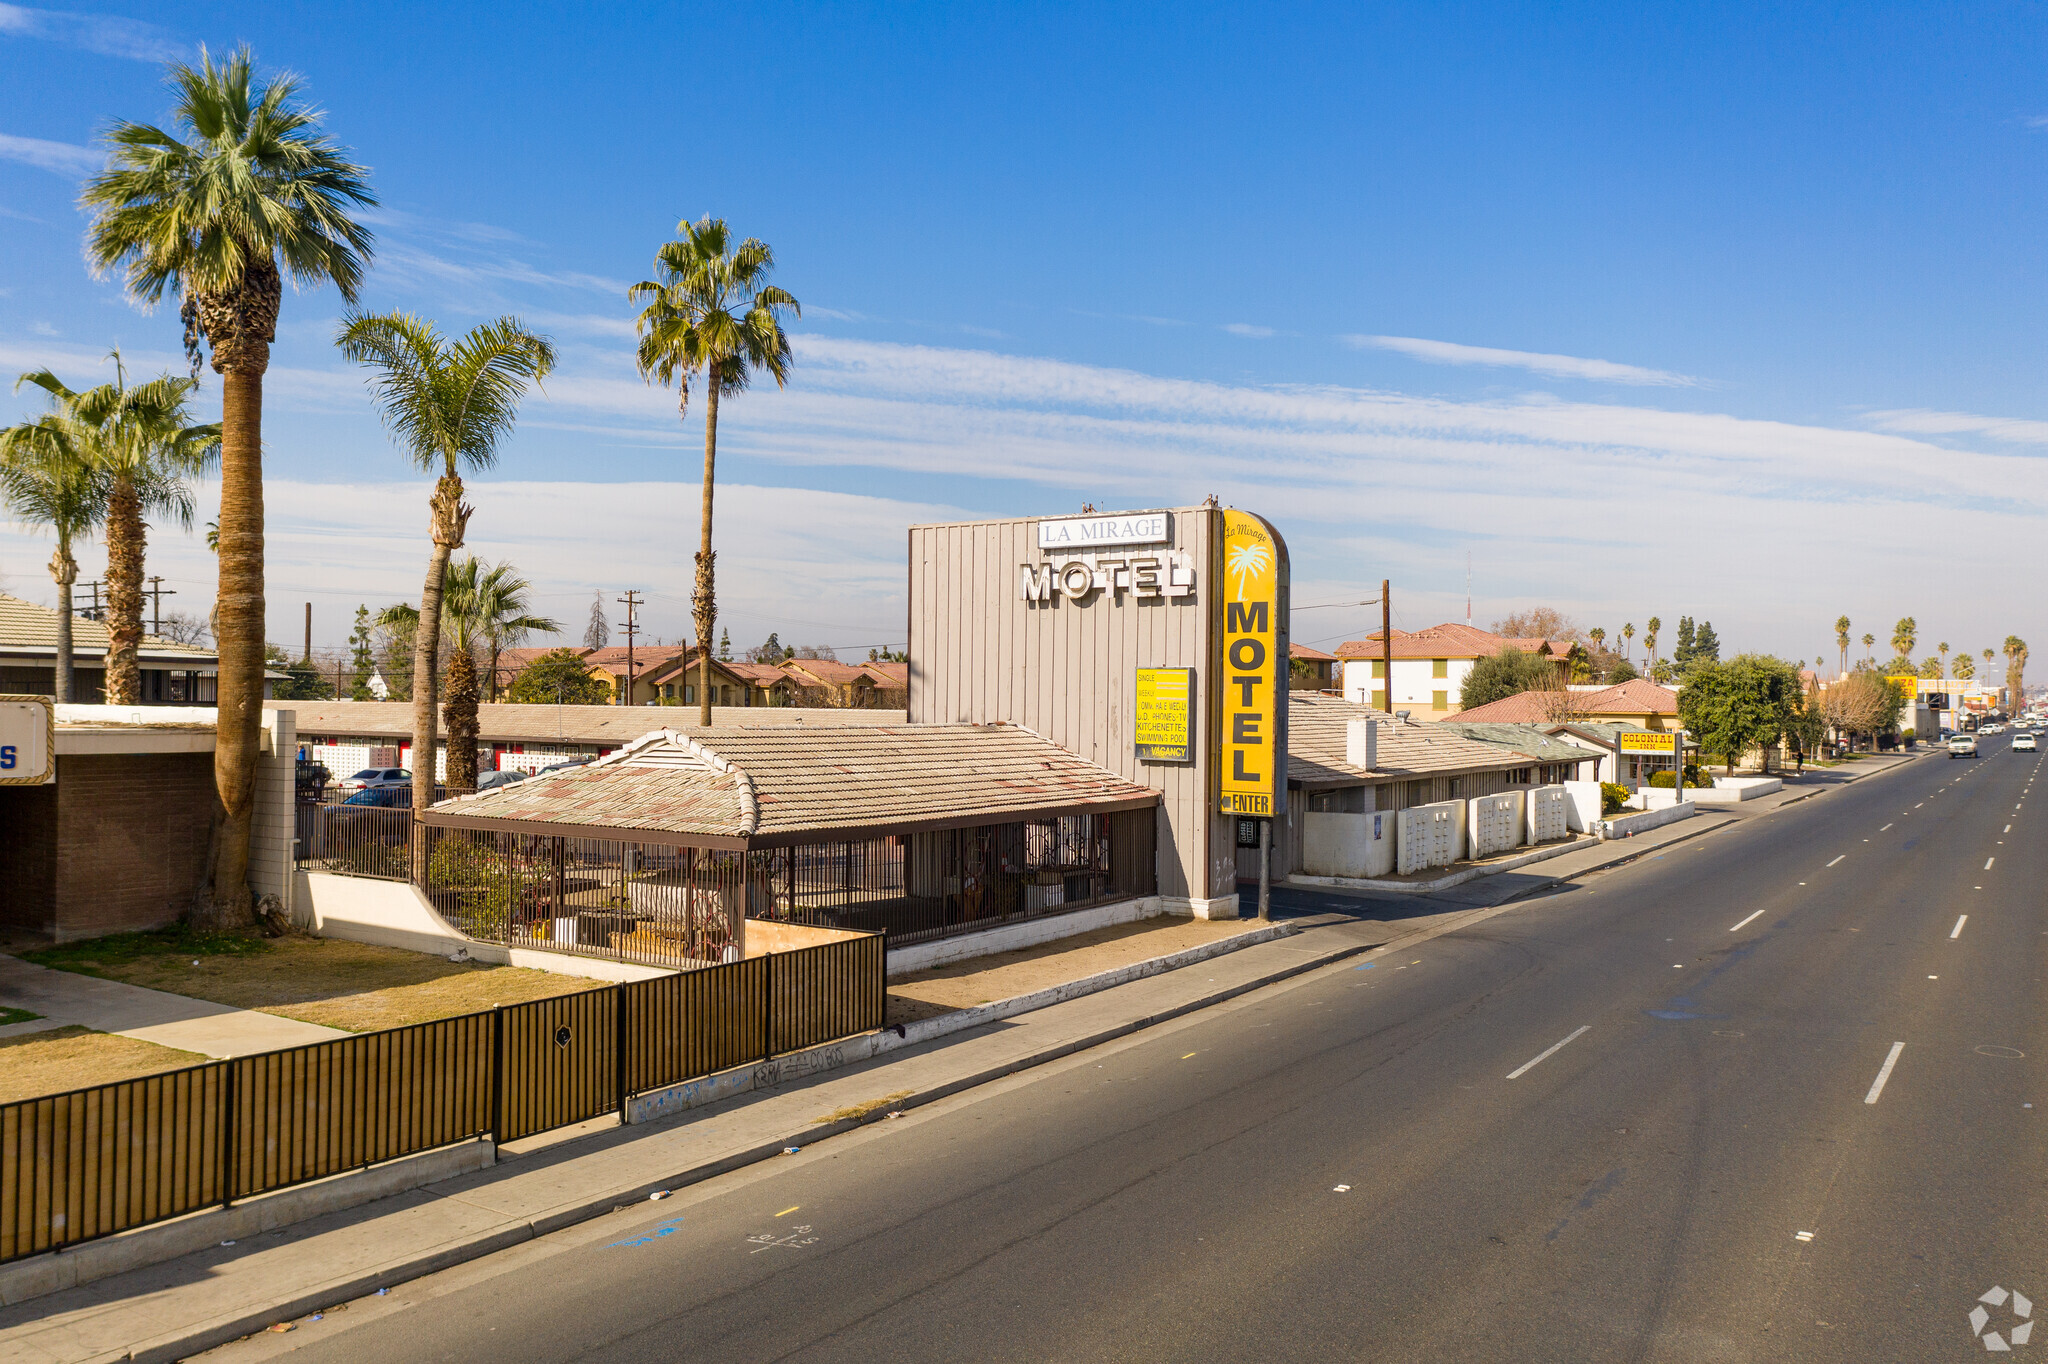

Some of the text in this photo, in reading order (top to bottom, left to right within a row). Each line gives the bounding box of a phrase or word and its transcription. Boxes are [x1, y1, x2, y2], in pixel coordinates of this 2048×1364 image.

[1045, 518, 1163, 542] LA MIRAGE
[1226, 523, 1267, 543] La Mirage
[1019, 557, 1189, 601] MOTEL
[1138, 674, 1155, 682] SINGLE
[1928, 680, 1974, 688] BEAUTY
[1227, 601, 1269, 782] MOTEL
[1136, 722, 1187, 732] KITCHENETTES
[1136, 733, 1187, 743] SWIMMING POOL
[1623, 734, 1673, 743] COLONIAL
[1151, 746, 1186, 757] VACANCY
[1232, 793, 1269, 813] ENTER
